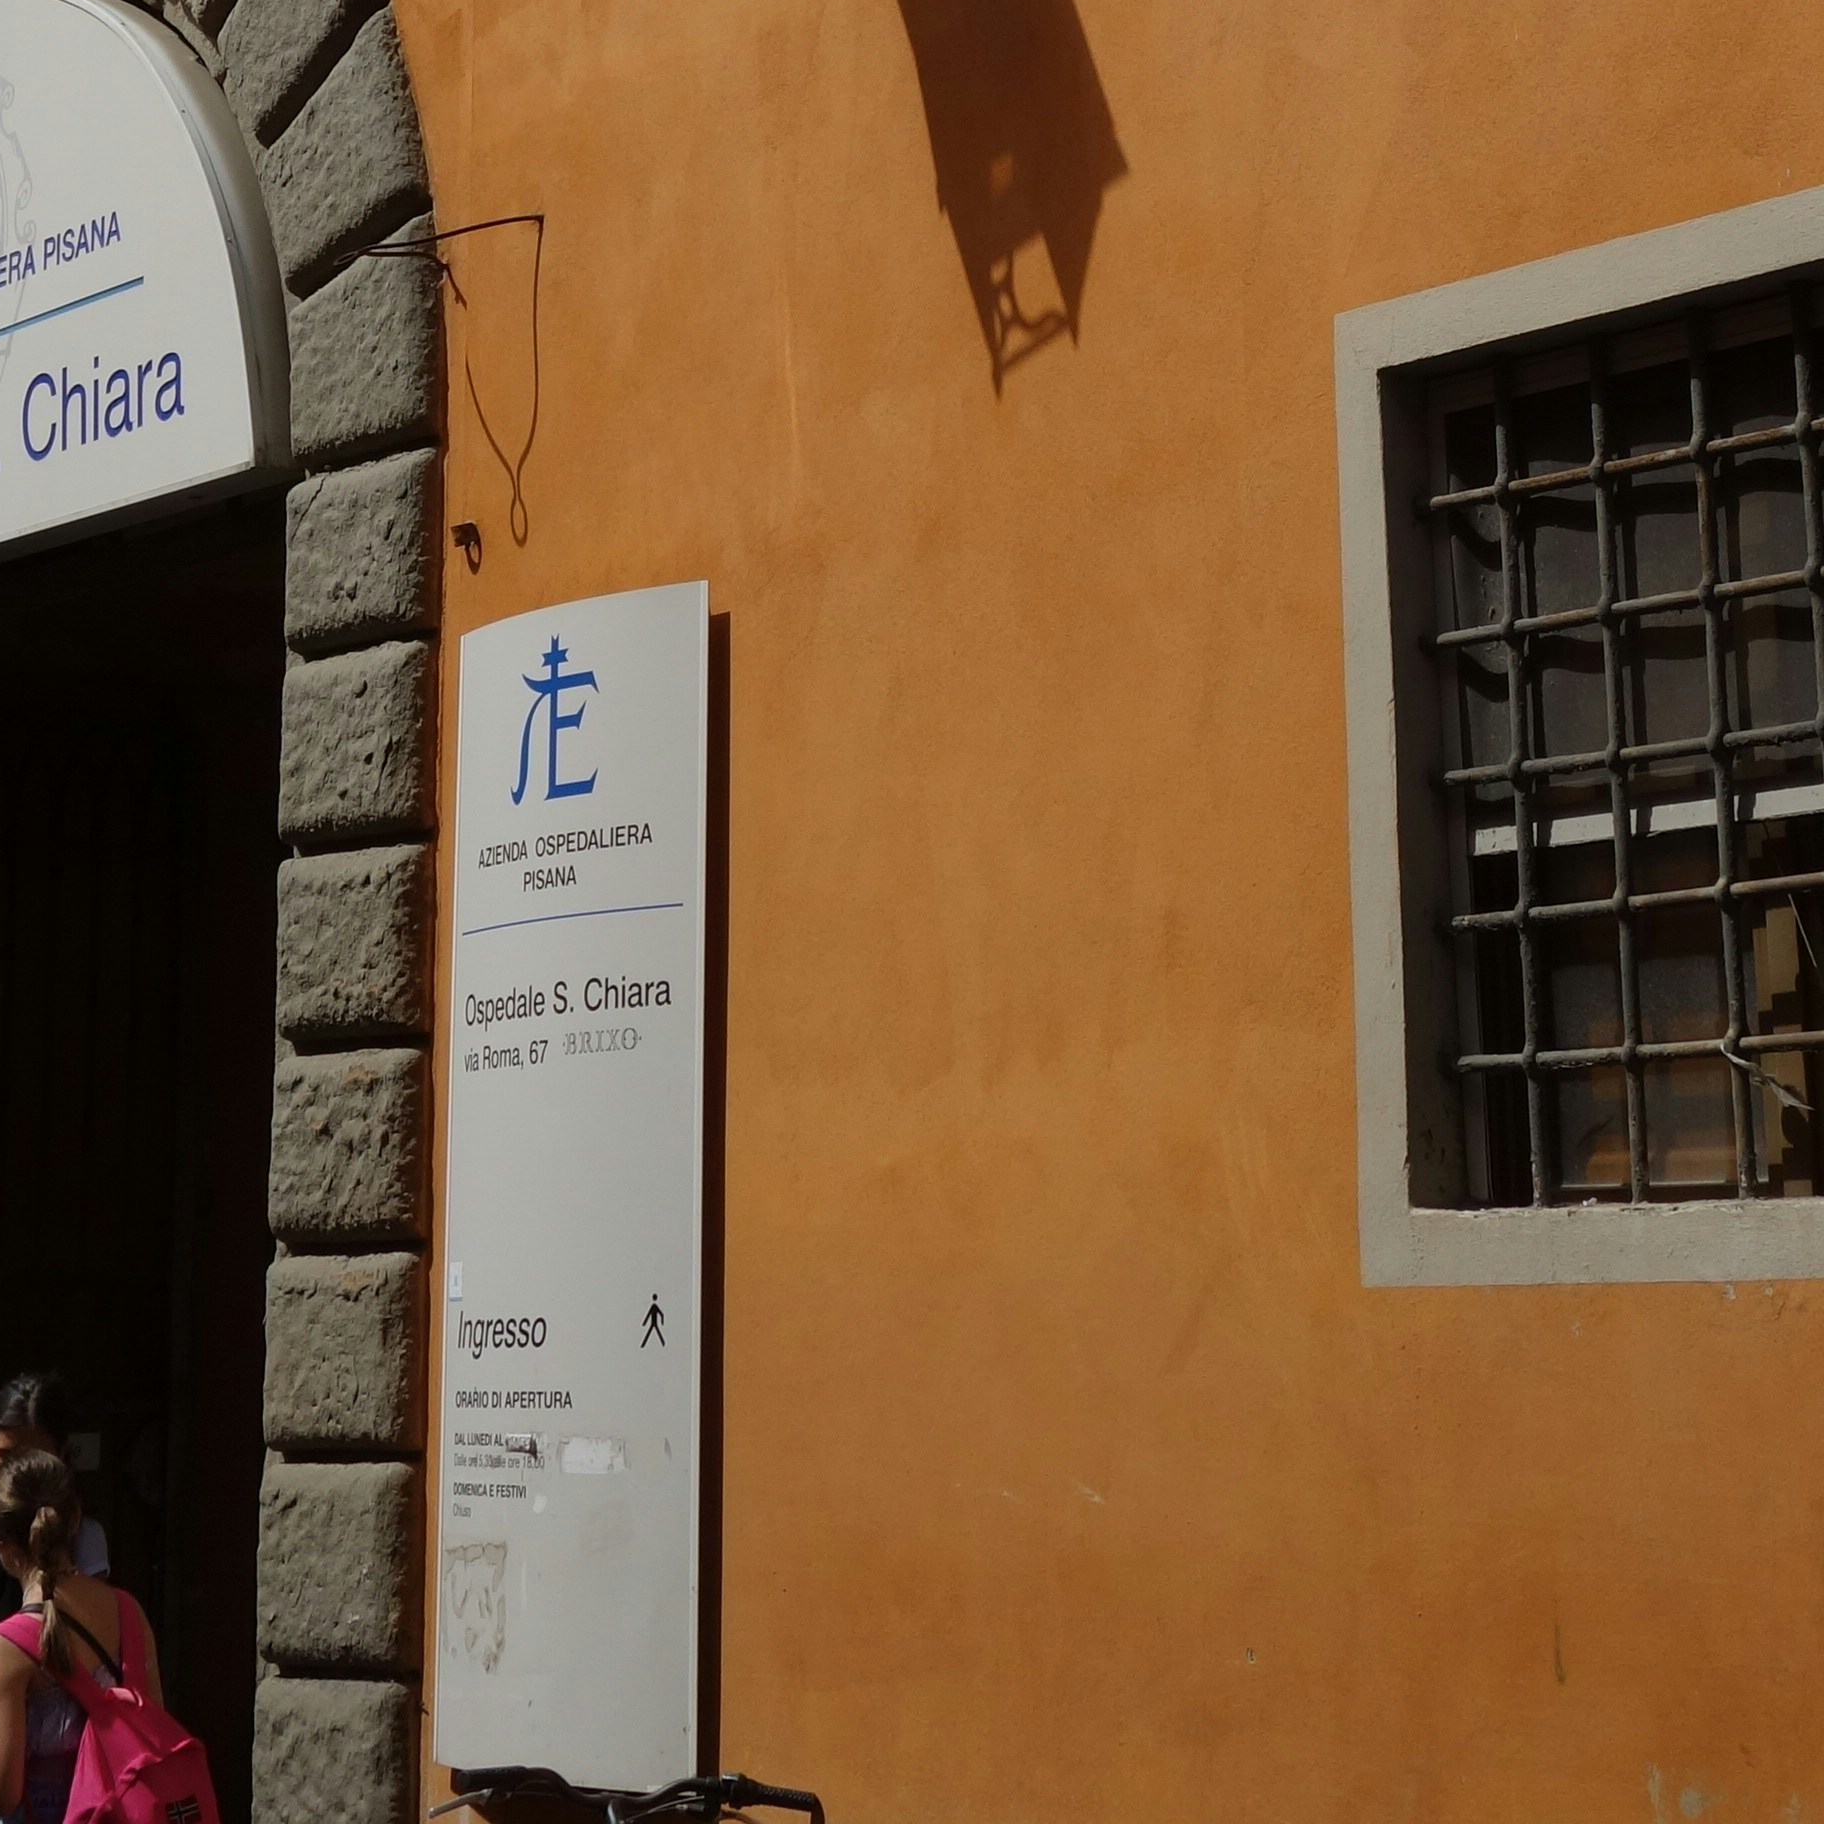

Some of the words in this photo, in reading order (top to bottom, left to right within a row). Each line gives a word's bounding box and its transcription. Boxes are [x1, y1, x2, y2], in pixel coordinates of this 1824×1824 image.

[43, 211, 122, 271] PISANA
[22, 350, 186, 462] Chiara
[478, 839, 528, 869] AZIENDA
[535, 822, 653, 858] OSPEDALIERA
[522, 865, 577, 892] PISANA
[464, 987, 546, 1032] Ospedale
[552, 980, 575, 1015] S.
[583, 976, 672, 1012] Chiara
[464, 1046, 480, 1073] via
[482, 1044, 526, 1071] Roma,
[529, 1039, 549, 1065] 67
[457, 1310, 547, 1359] Ingresso
[455, 1391, 489, 1408] ORARIO
[491, 1391, 502, 1408] DI
[504, 1391, 573, 1409] APERTURA
[454, 1433, 466, 1446] DAL
[494, 1434, 504, 1446] AL
[507, 1458, 520, 1468] ore
[453, 1482, 487, 1496] DOMENICA
[489, 1484, 494, 1497] E
[496, 1484, 526, 1498] FESTIVI
[453, 1503, 471, 1517] Chiuso
